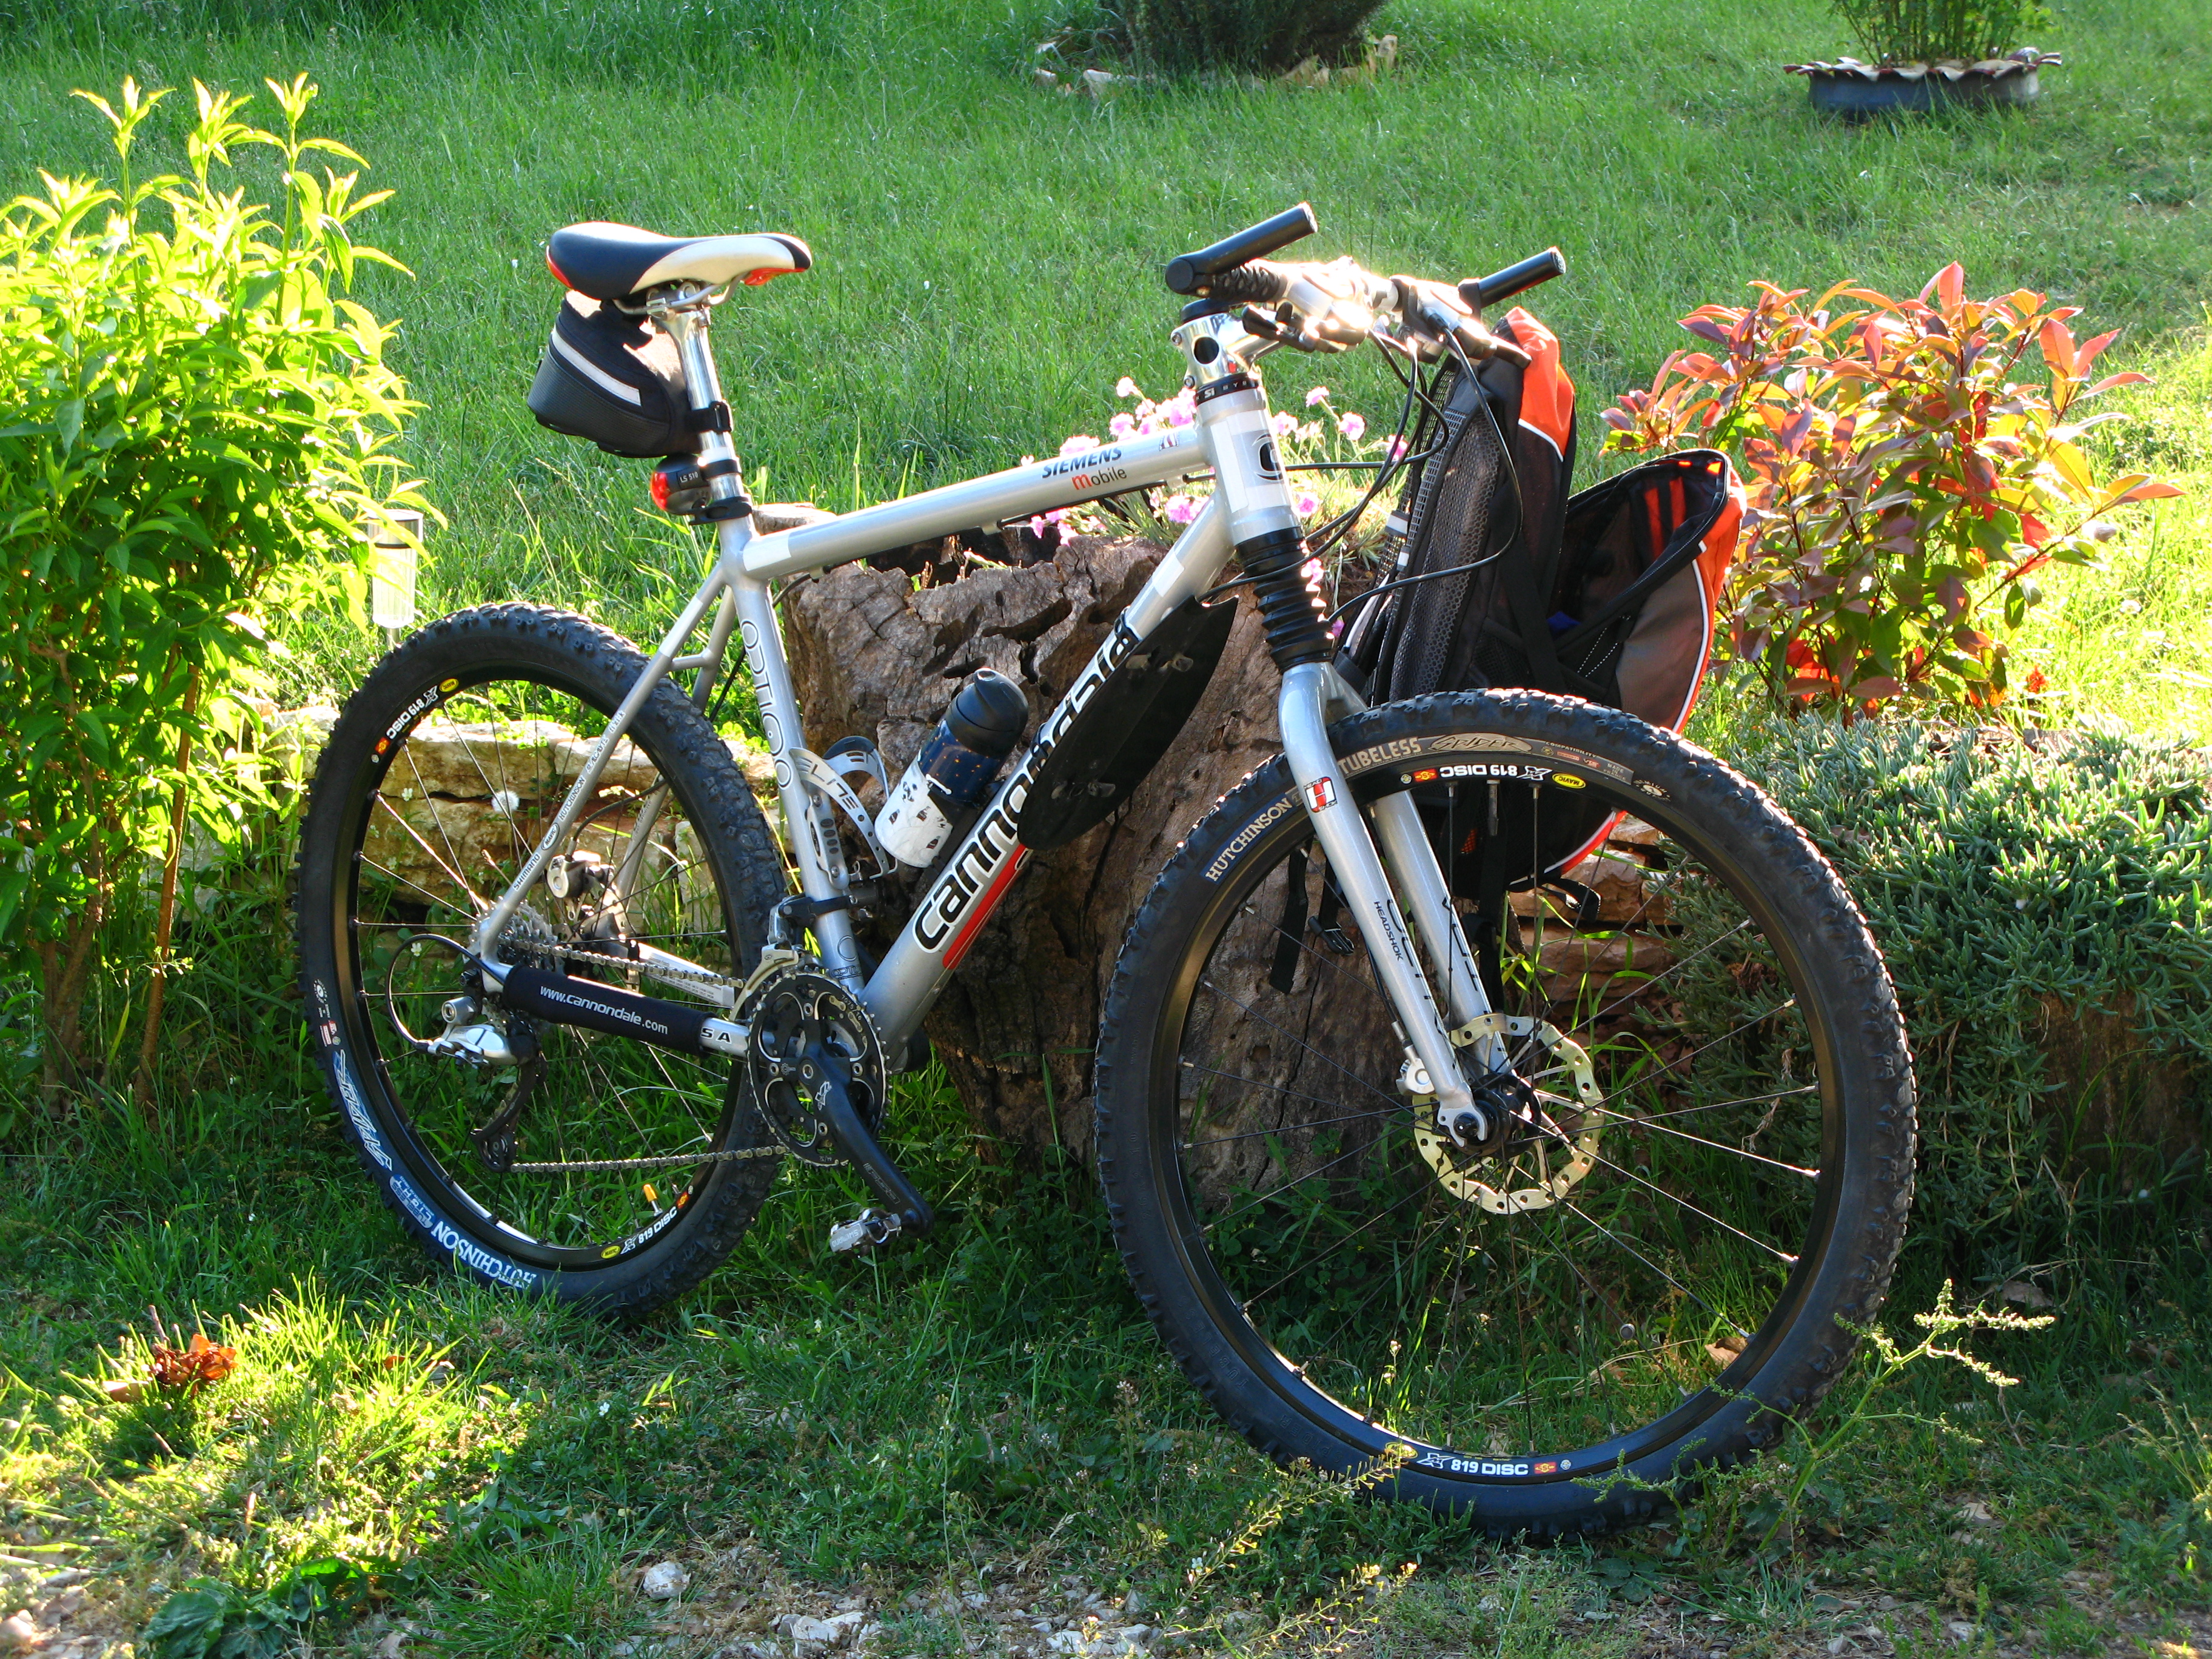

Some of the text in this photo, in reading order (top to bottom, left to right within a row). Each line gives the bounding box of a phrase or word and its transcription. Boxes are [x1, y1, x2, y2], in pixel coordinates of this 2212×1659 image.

[1042, 446, 1122, 479] SIEMENS
[1071, 466, 1128, 491] mobile
[386, 711, 412, 739] DISC
[407, 698, 425, 716] 819
[1336, 736, 1422, 774] TUBELESS
[1439, 765, 1487, 778] DISC
[1490, 765, 1518, 777] 819
[559, 776, 586, 821] HUTCHINSON
[1558, 776, 1581, 786] MAVIC
[1205, 797, 1293, 882] HUTCHINSON
[513, 853, 540, 891] SHIMANO
[1373, 901, 1404, 962] HEADSHOK
[540, 985, 669, 1035] www.cannondale.com
[391, 1182, 426, 1226] TUBELESS
[397, 1180, 432, 1221] LIGHT
[638, 1227, 653, 1244] 819
[654, 1206, 678, 1234] DISC
[431, 1221, 537, 1289] HUTCHINSON
[1451, 1460, 1478, 1474] 819
[1481, 1463, 1529, 1476] DISC
